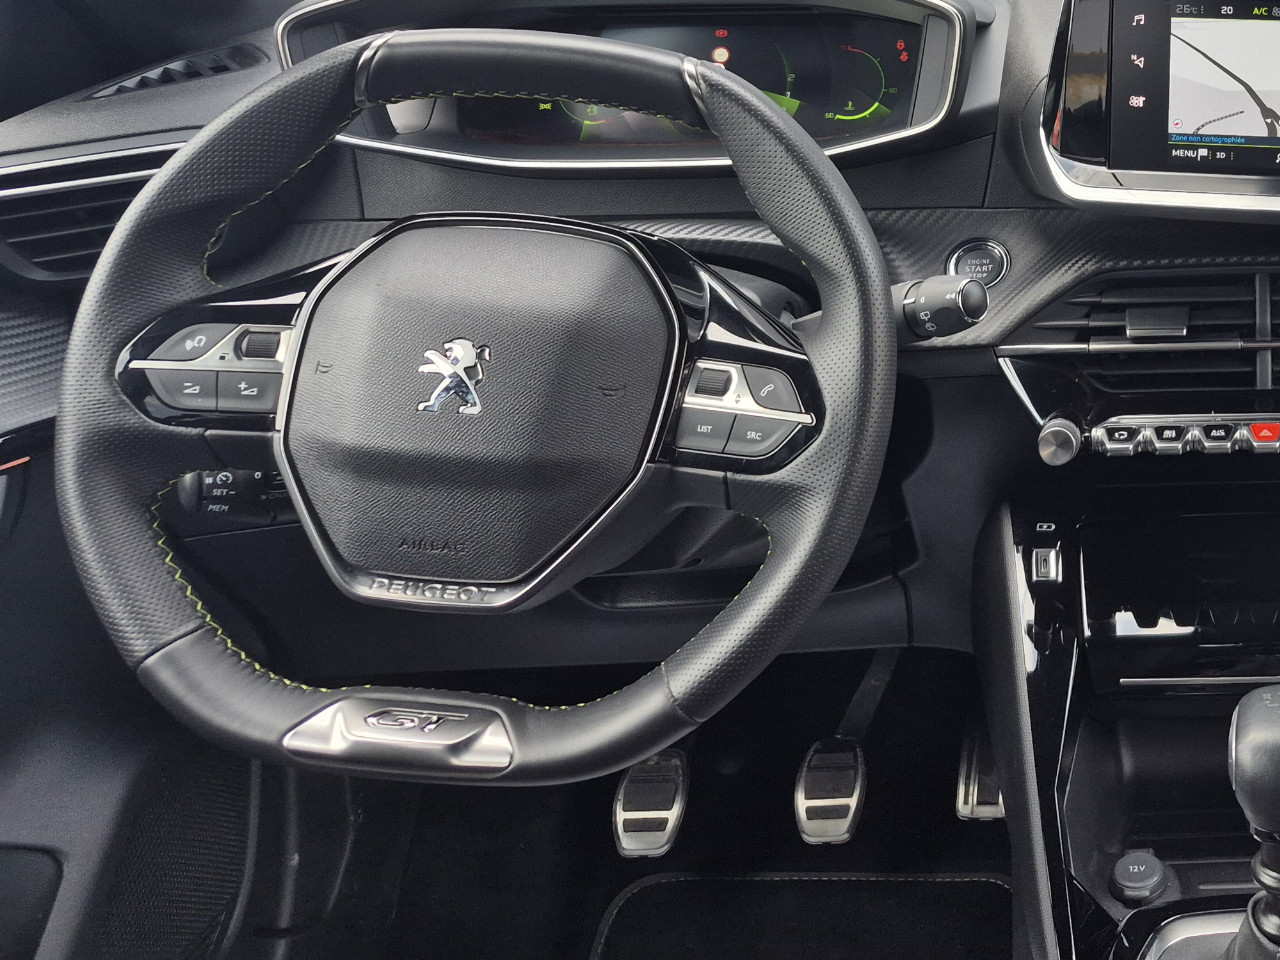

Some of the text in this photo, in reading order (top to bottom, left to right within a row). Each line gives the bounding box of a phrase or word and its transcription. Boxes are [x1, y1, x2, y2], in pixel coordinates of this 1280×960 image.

[1221, 6, 1233, 14] 20
[1252, 7, 1268, 15] A/C
[1172, 149, 1197, 158] MENU
[965, 264, 994, 272] START
[697, 424, 713, 433] LIST
[746, 431, 763, 440] SRC
[207, 504, 230, 512] MEM
[369, 577, 497, 602] PEUGEOT
[364, 707, 469, 734] GT
[1128, 864, 1146, 872] 12V
